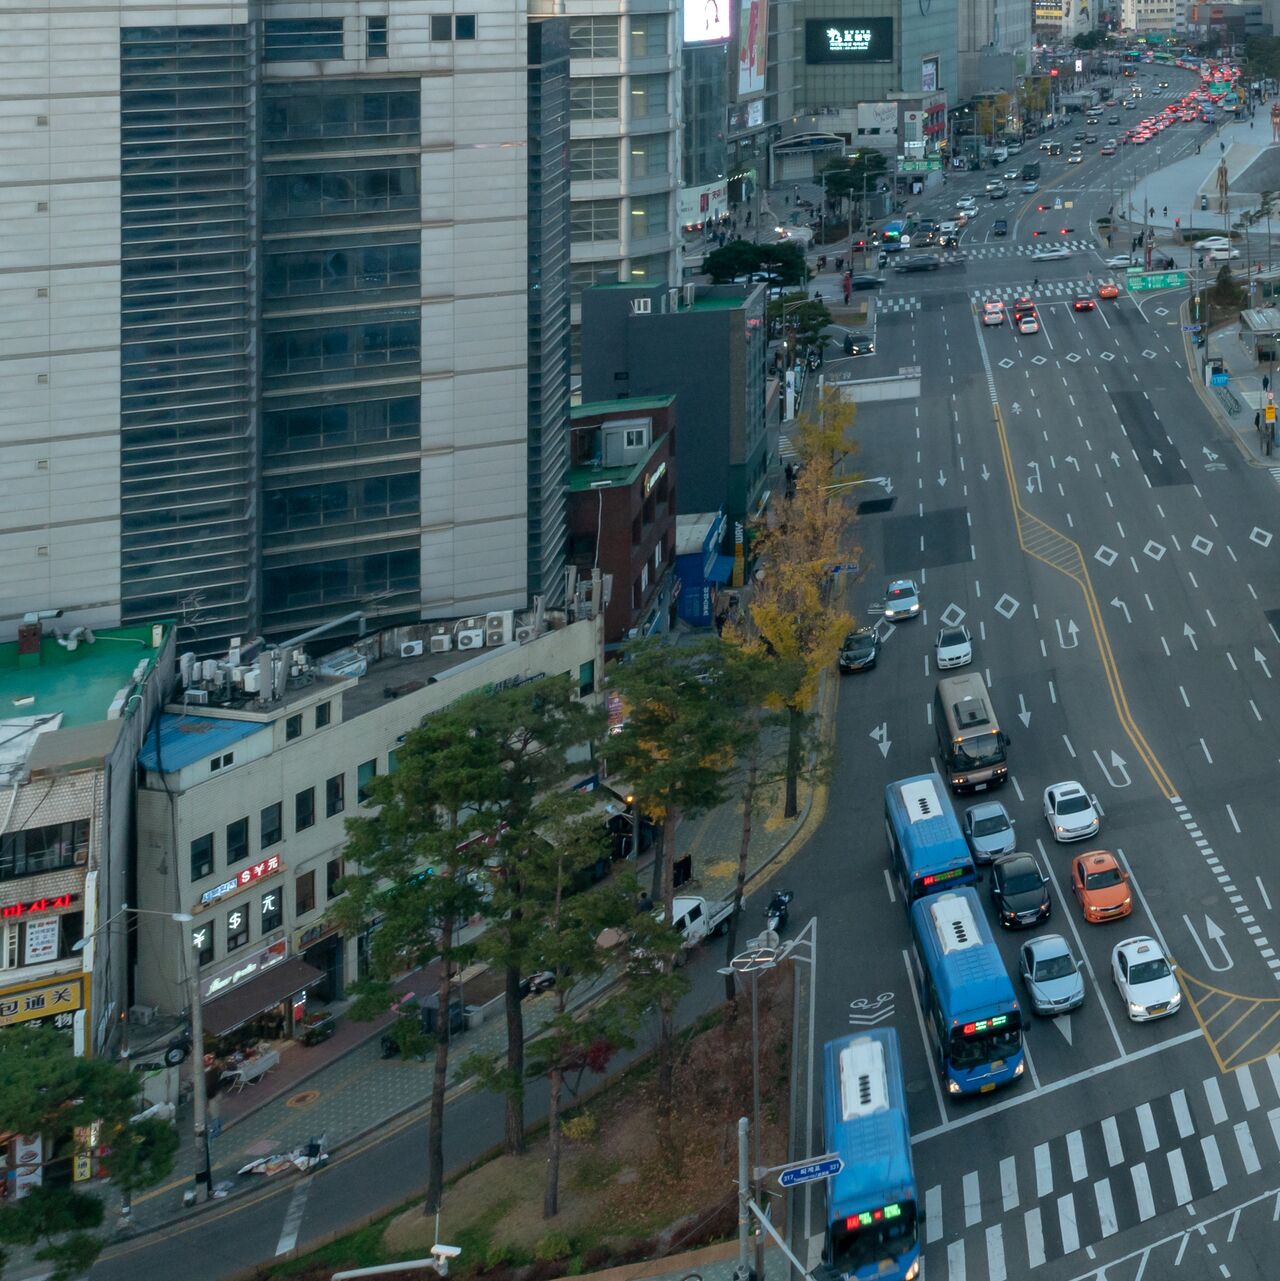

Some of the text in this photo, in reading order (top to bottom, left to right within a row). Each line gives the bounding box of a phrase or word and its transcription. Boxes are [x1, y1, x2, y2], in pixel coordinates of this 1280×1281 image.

[2, 893, 72, 918] 마사지
[228, 911, 242, 929] $
[192, 928, 206, 948] ¥
